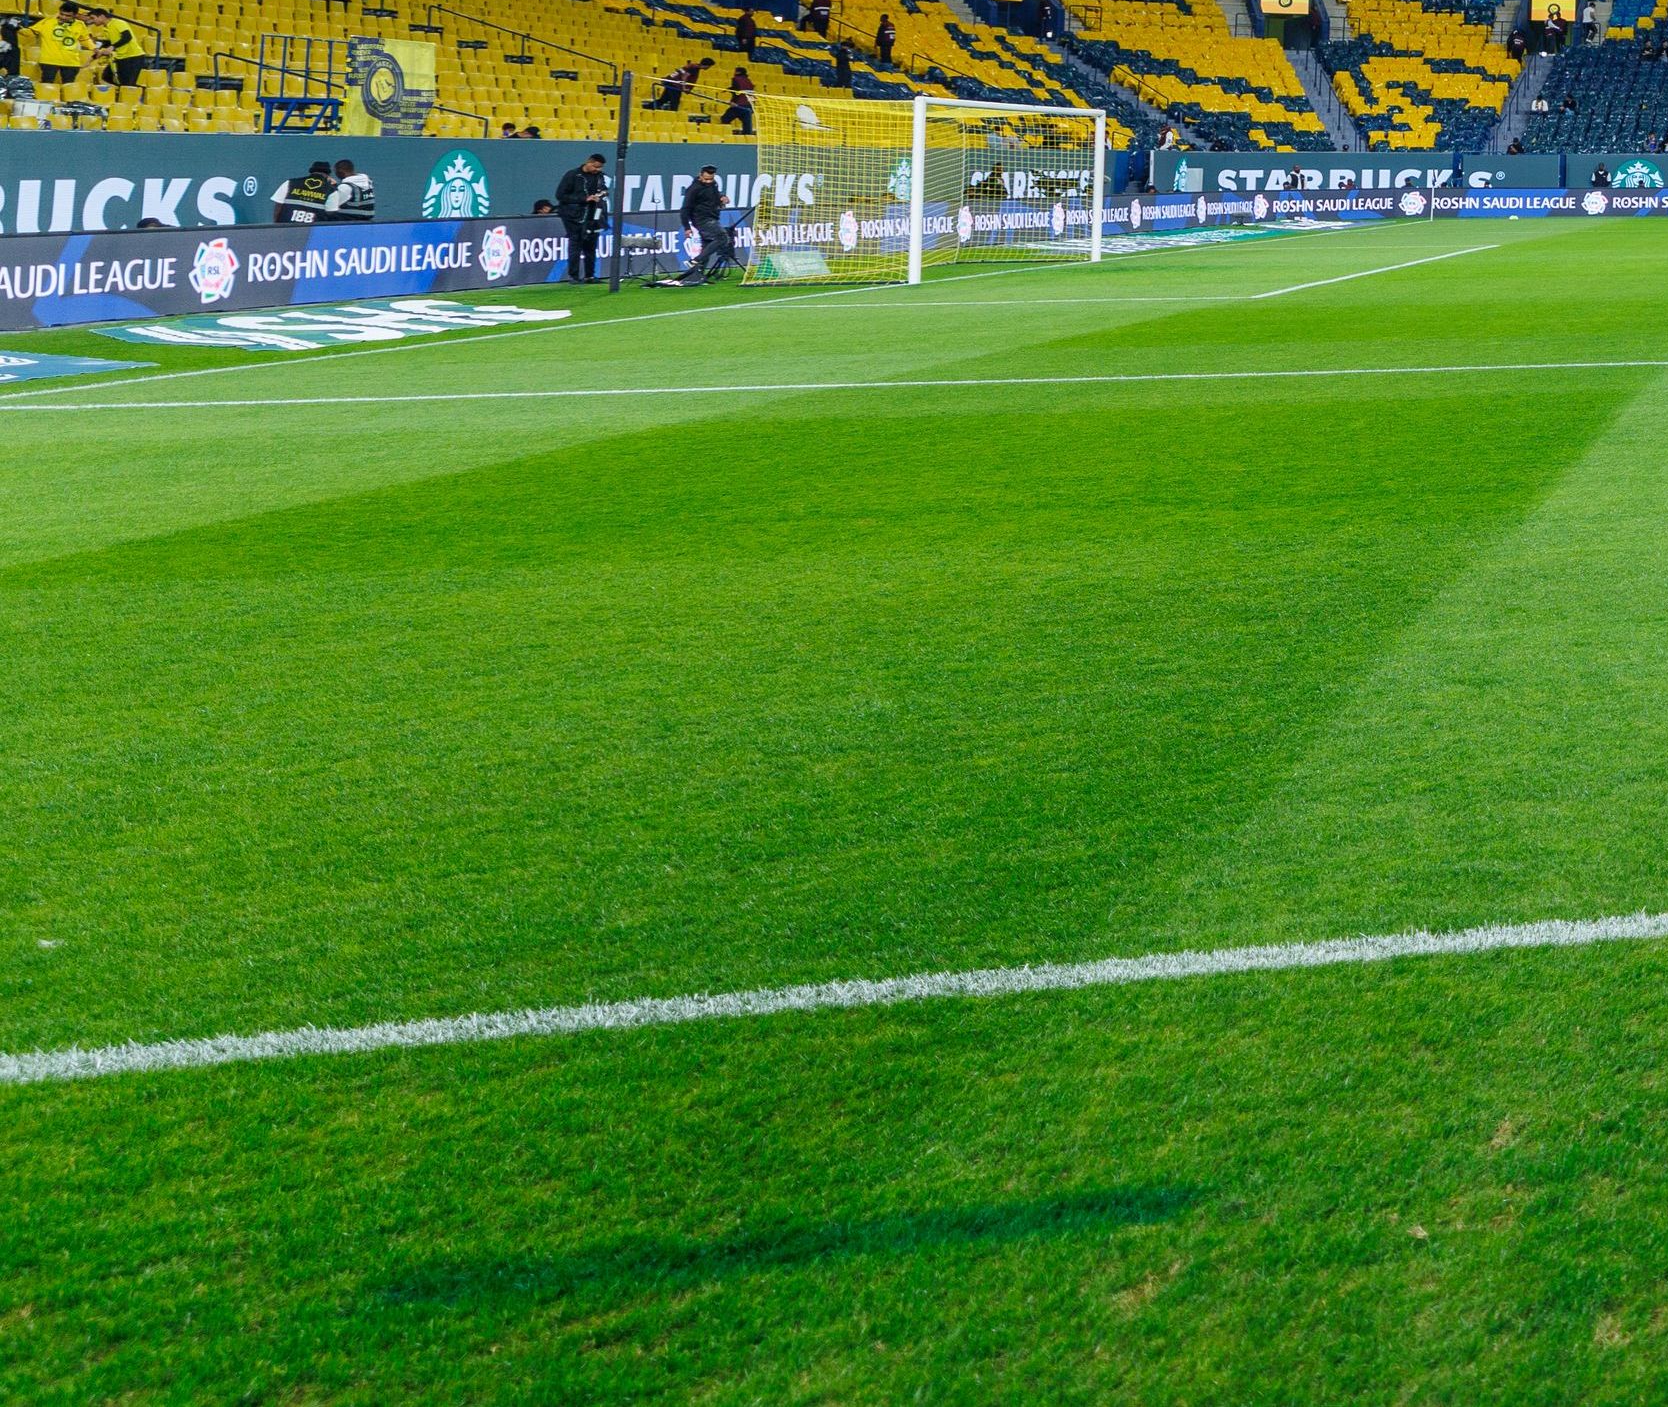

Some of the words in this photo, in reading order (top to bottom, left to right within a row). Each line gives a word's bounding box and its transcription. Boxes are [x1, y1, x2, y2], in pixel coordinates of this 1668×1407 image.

[1272, 200, 1314, 212] ROSHN
[1316, 200, 1350, 211] SAUDI
[1352, 198, 1393, 209] LEAGUE
[1433, 198, 1479, 208] ROSHN
[1483, 198, 1523, 208] SAUDI
[1527, 198, 1575, 208] LEAGUE
[1612, 197, 1658, 208] ROSHN
[290, 209, 316, 224] 188
[1025, 211, 1050, 228] LEAGUE
[794, 222, 834, 243] LEAGUE
[861, 219, 894, 239] ROSHN
[923, 216, 954, 235] LEAGUE
[247, 249, 329, 283] ROSHN
[333, 246, 395, 277] SAUDI
[401, 241, 472, 272] LEAGUE
[73, 257, 177, 295] LEAGUE
